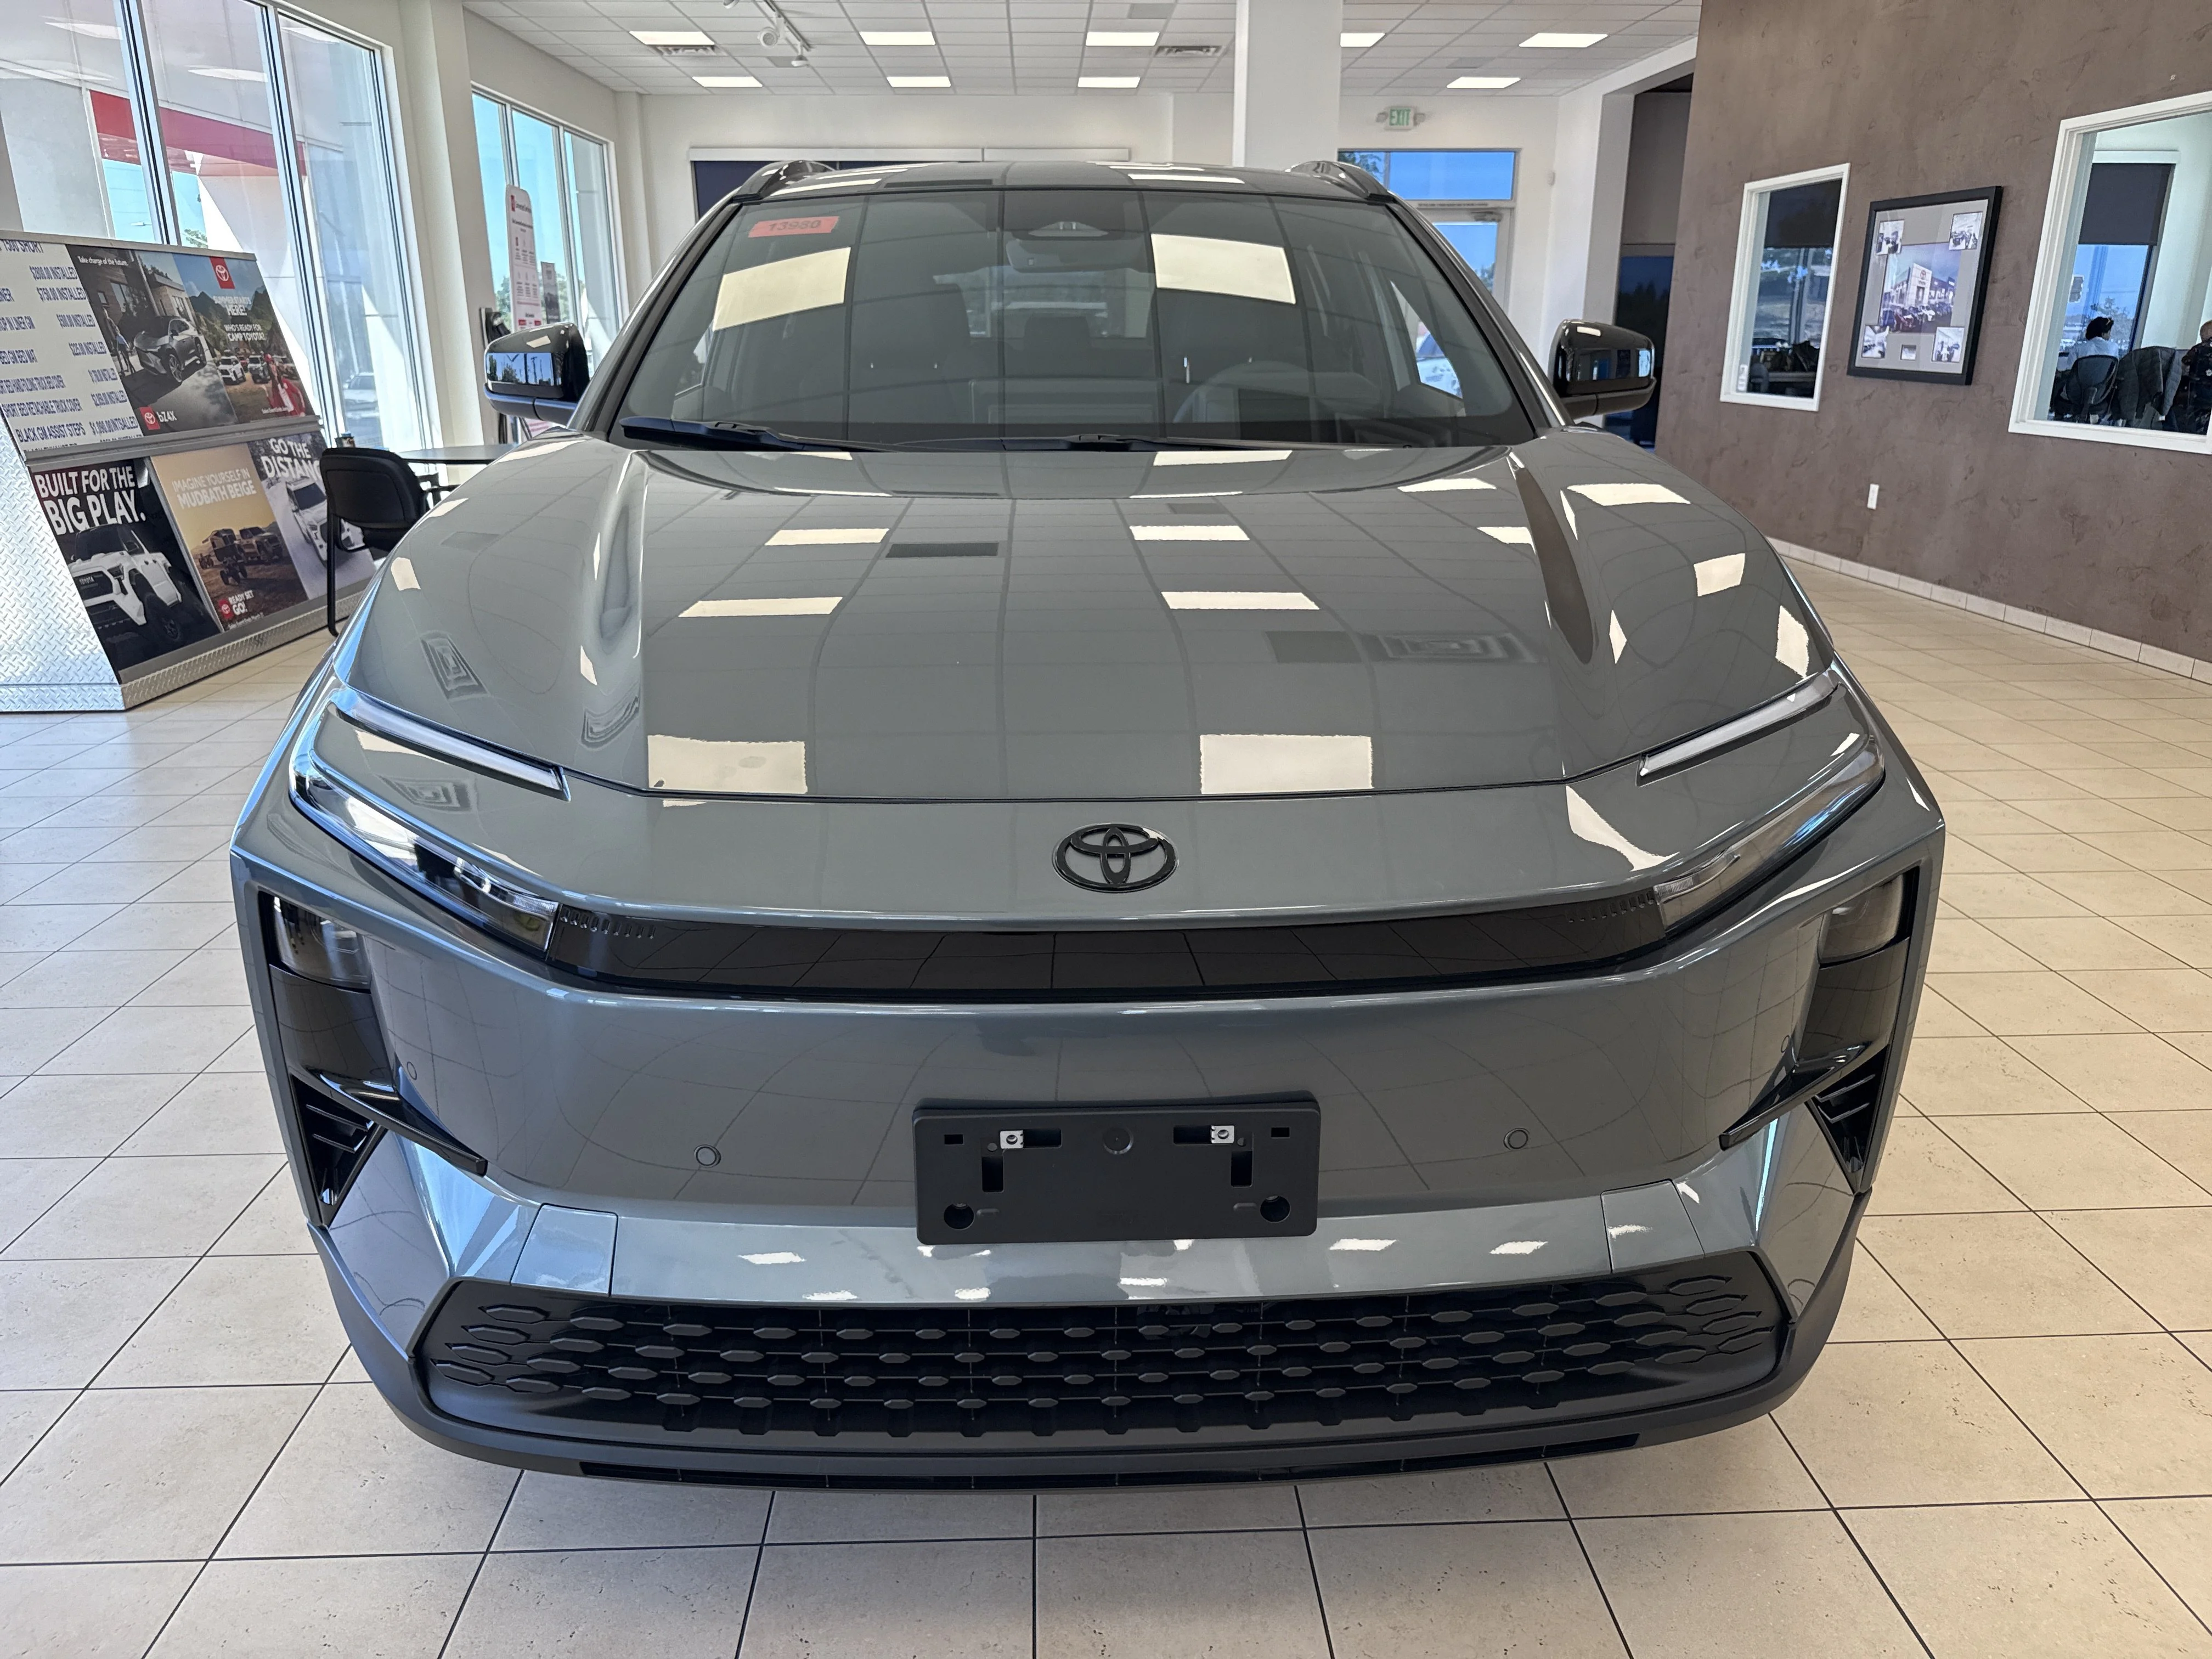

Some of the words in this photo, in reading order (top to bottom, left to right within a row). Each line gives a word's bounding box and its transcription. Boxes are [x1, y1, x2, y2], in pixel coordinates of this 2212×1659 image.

[1389, 109, 1411, 126] EXIT
[18, 240, 44, 253] SHORT
[49, 266, 77, 280] INSTALLED
[36, 287, 59, 302] $750.00
[55, 287, 87, 300] INSTALLED
[225, 304, 247, 316] HERE!
[71, 314, 96, 328] INSTALLED
[228, 332, 244, 341] CAMP
[82, 341, 107, 355] INSTALLED
[156, 410, 177, 422] bZ4X
[15, 427, 40, 443] BLACK
[36, 426, 49, 441] GM
[47, 424, 68, 439] ASSIST
[66, 422, 86, 437] STEPS
[268, 438, 289, 455] GO
[287, 441, 311, 459] THE
[261, 456, 323, 482] DISTANC
[35, 471, 78, 498] BUILT
[82, 469, 110, 493] FOR
[110, 466, 136, 489] THE
[171, 476, 207, 493] IMAGINE
[205, 469, 241, 486] YOURSELF
[240, 467, 251, 479] IN
[177, 485, 229, 510] MUDBATH
[227, 480, 257, 499] BEIGE
[43, 496, 91, 535] BIG
[87, 489, 146, 527] PLAY.
[228, 592, 245, 604] READY
[232, 601, 248, 616] GO!
